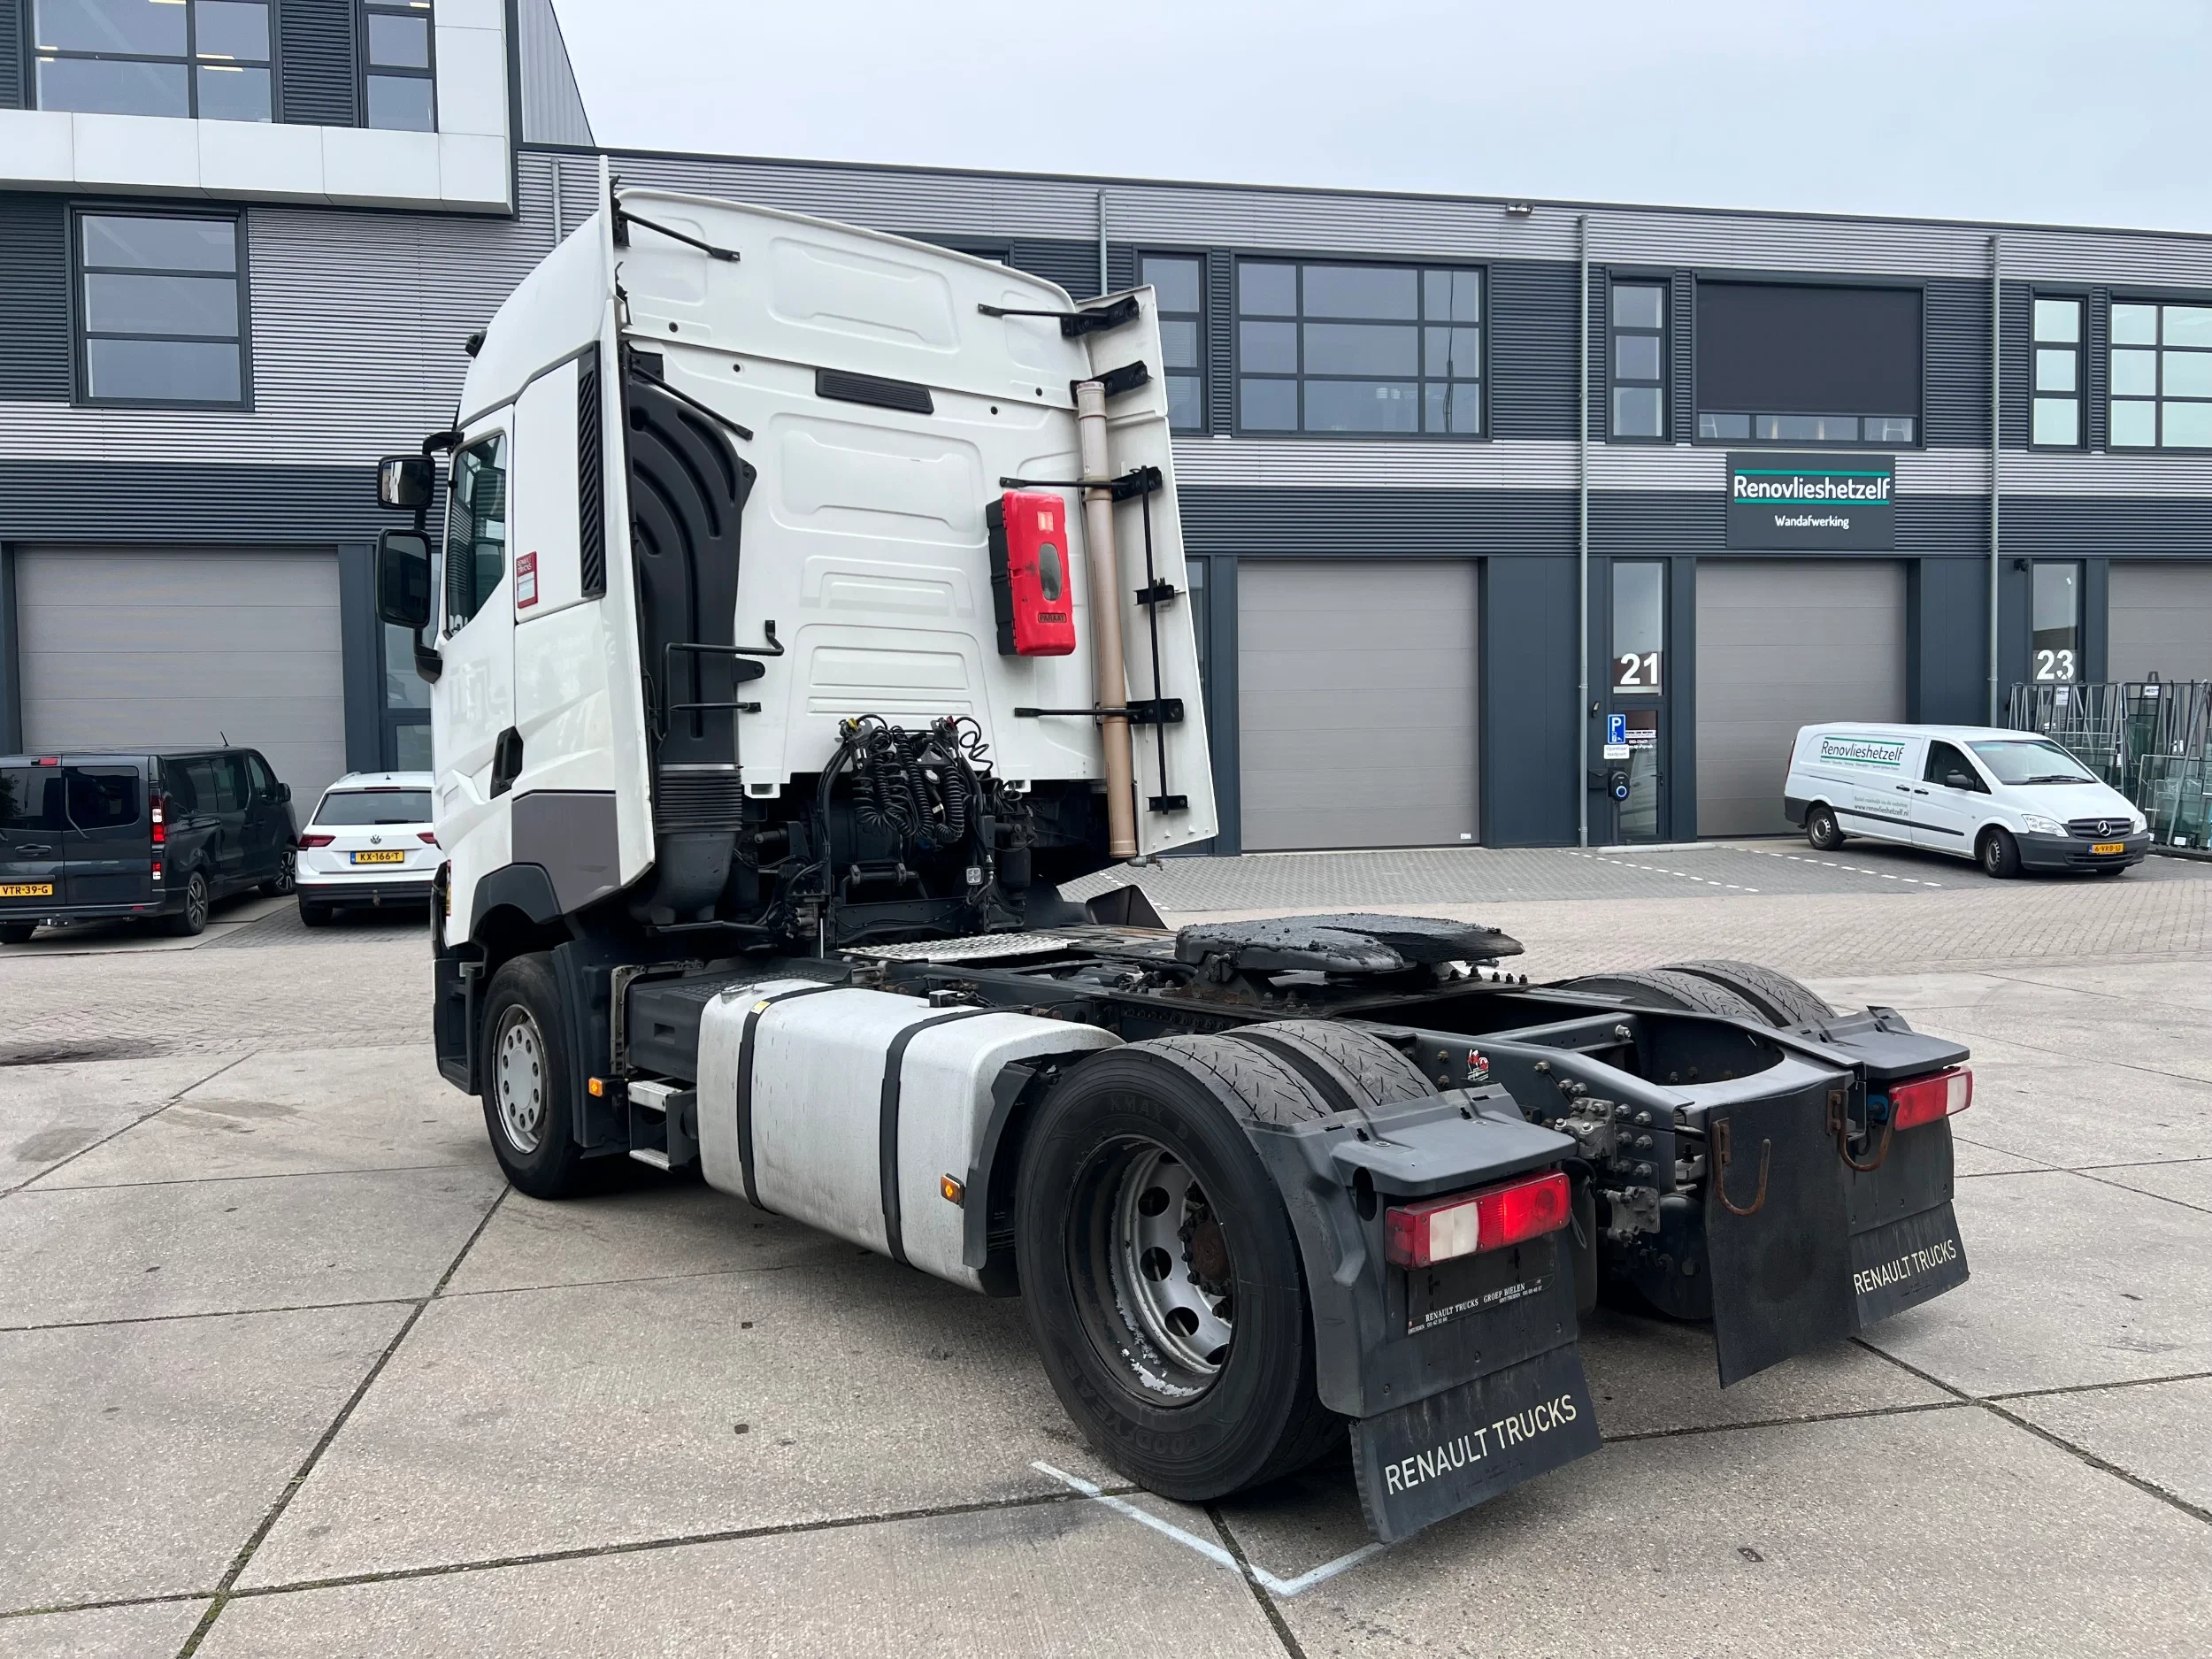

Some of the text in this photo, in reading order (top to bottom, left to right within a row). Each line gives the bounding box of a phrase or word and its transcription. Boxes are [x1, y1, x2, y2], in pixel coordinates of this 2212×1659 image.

[1733, 475, 1891, 500] Renovlieshetzelf
[1774, 515, 1850, 529] Wandafwerking
[1620, 653, 1658, 685] 21
[2037, 649, 2074, 680] 23
[1611, 717, 1622, 731] P
[1821, 741, 1904, 762] Renovlieshetzelf
[360, 852, 400, 861] KX-166-T
[2, 885, 49, 895] VTR-39-G
[1853, 1256, 1911, 1294] RENAULT
[1910, 1239, 1957, 1273] TRUCKS
[1425, 1282, 1525, 1323] RENAULT TRUCKS GROEP BIELEN
[1385, 1427, 1487, 1495] RENAULT
[1492, 1394, 1577, 1449] TRUCKS
